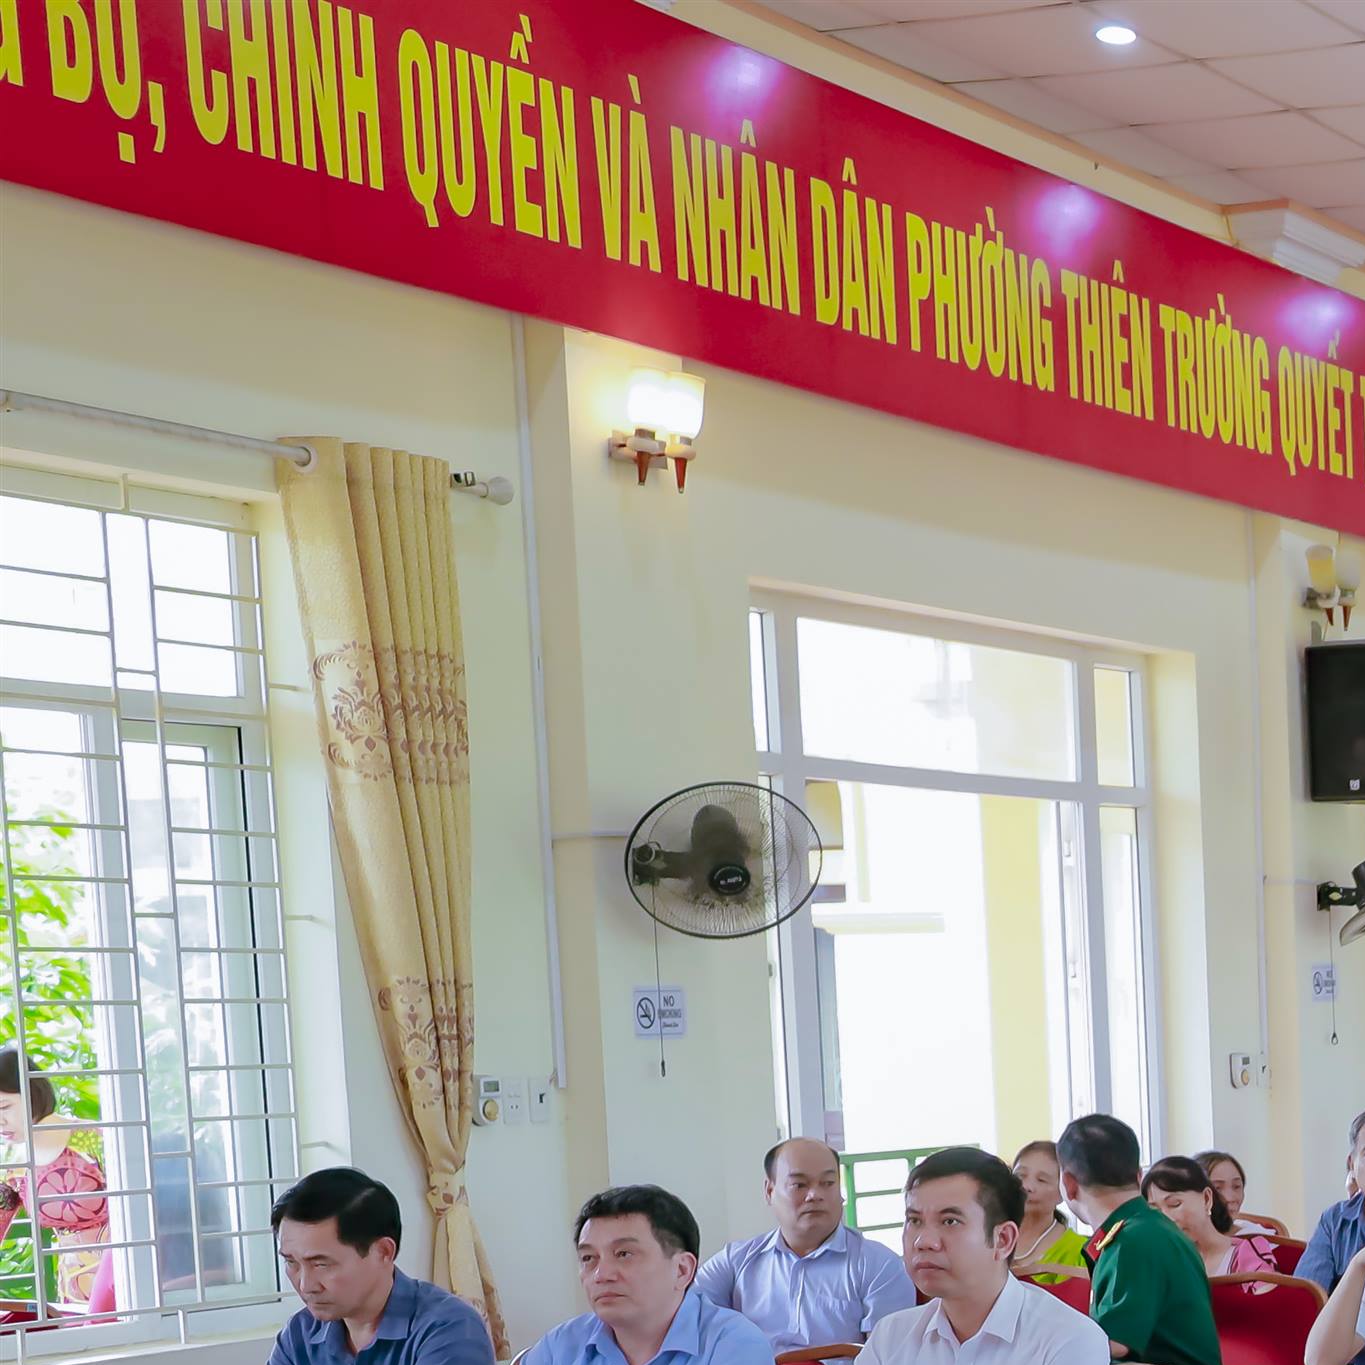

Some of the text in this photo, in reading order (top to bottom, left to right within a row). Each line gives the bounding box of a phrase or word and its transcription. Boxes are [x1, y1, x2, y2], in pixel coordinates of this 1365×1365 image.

[397, 14, 582, 249] QUYỀN
[591, 74, 662, 273] VÀ
[670, 118, 801, 315] NHÂN
[809, 157, 898, 345] DÂN
[905, 206, 1055, 392] PHƯỜNG
[1061, 260, 1154, 421] THIÊN
[1159, 293, 1273, 455] TRƯỜNG
[1278, 329, 1354, 476] QUYẾT
[662, 995, 675, 1007] NO
